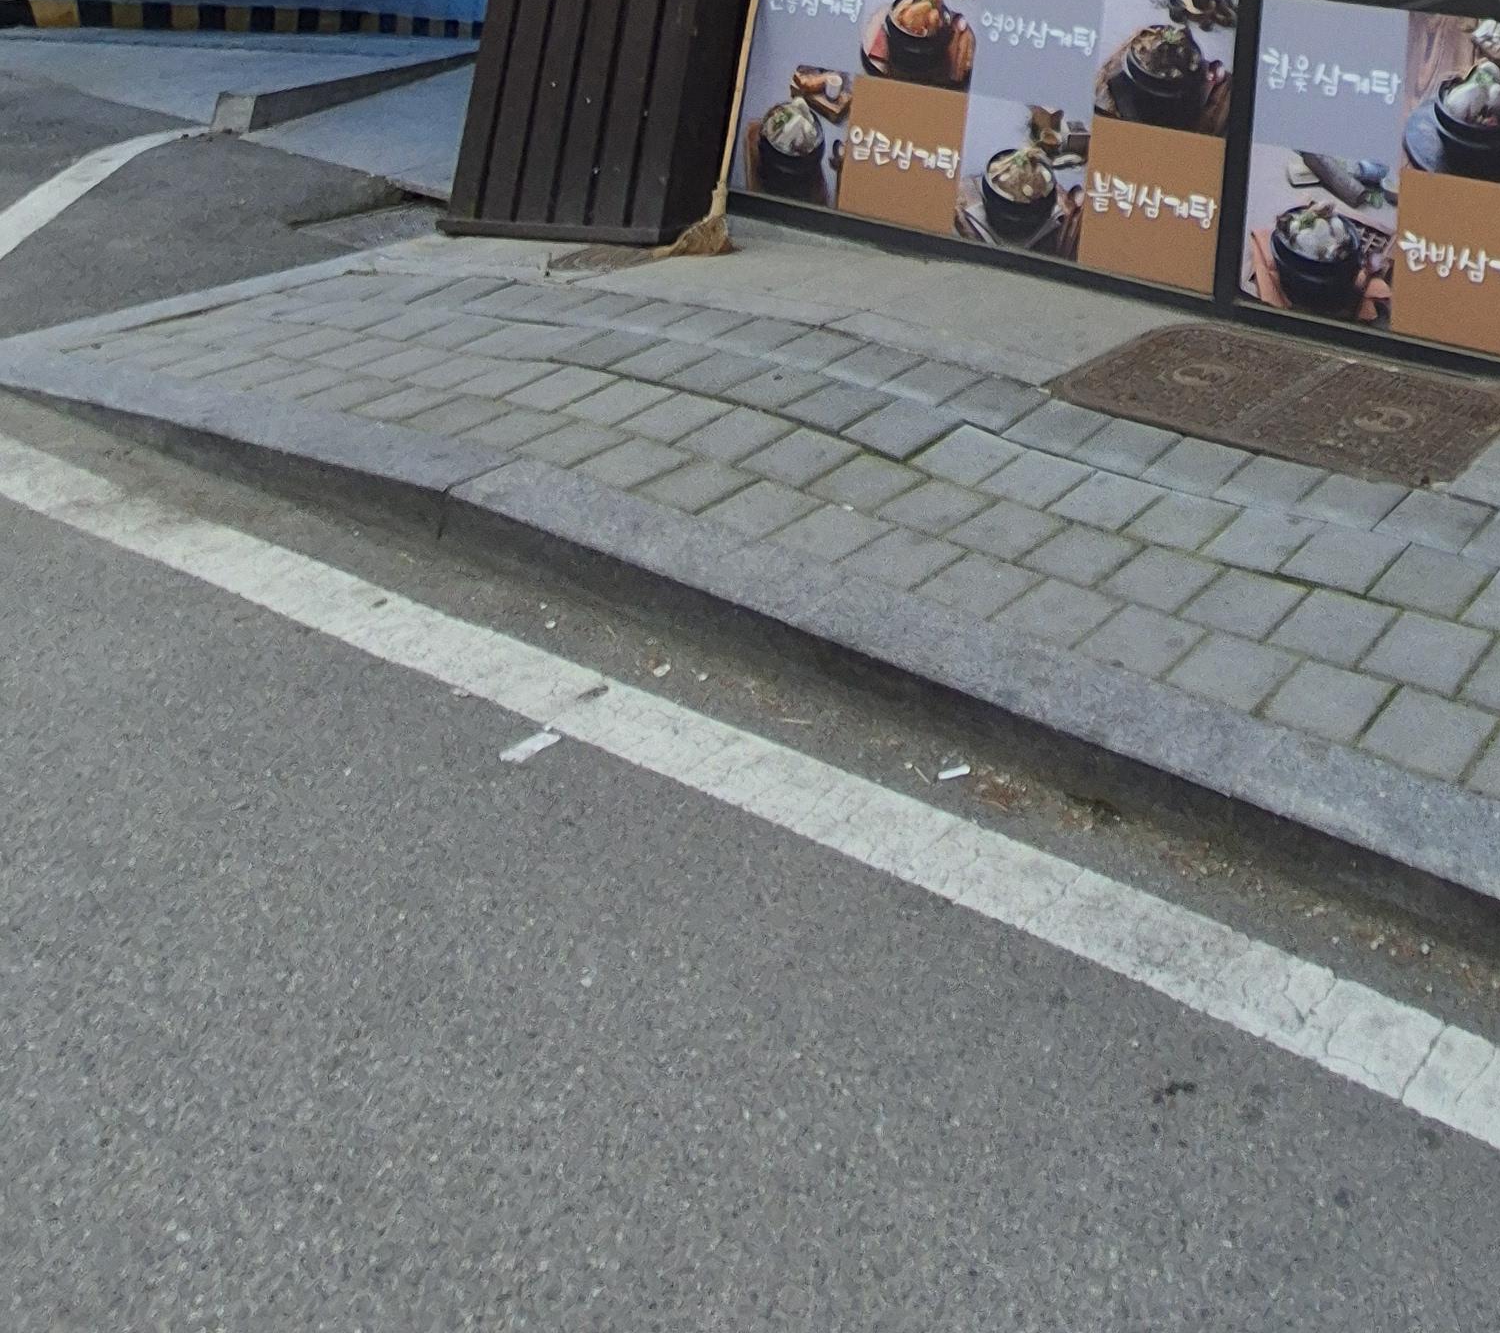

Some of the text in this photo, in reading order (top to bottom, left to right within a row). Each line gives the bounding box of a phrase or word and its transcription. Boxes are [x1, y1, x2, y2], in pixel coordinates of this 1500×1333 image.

[980, 9, 1098, 56] 영양삼계탕
[849, 126, 961, 180] 얼큰삼계탕
[1086, 170, 1219, 230] 블랙삼계탕
